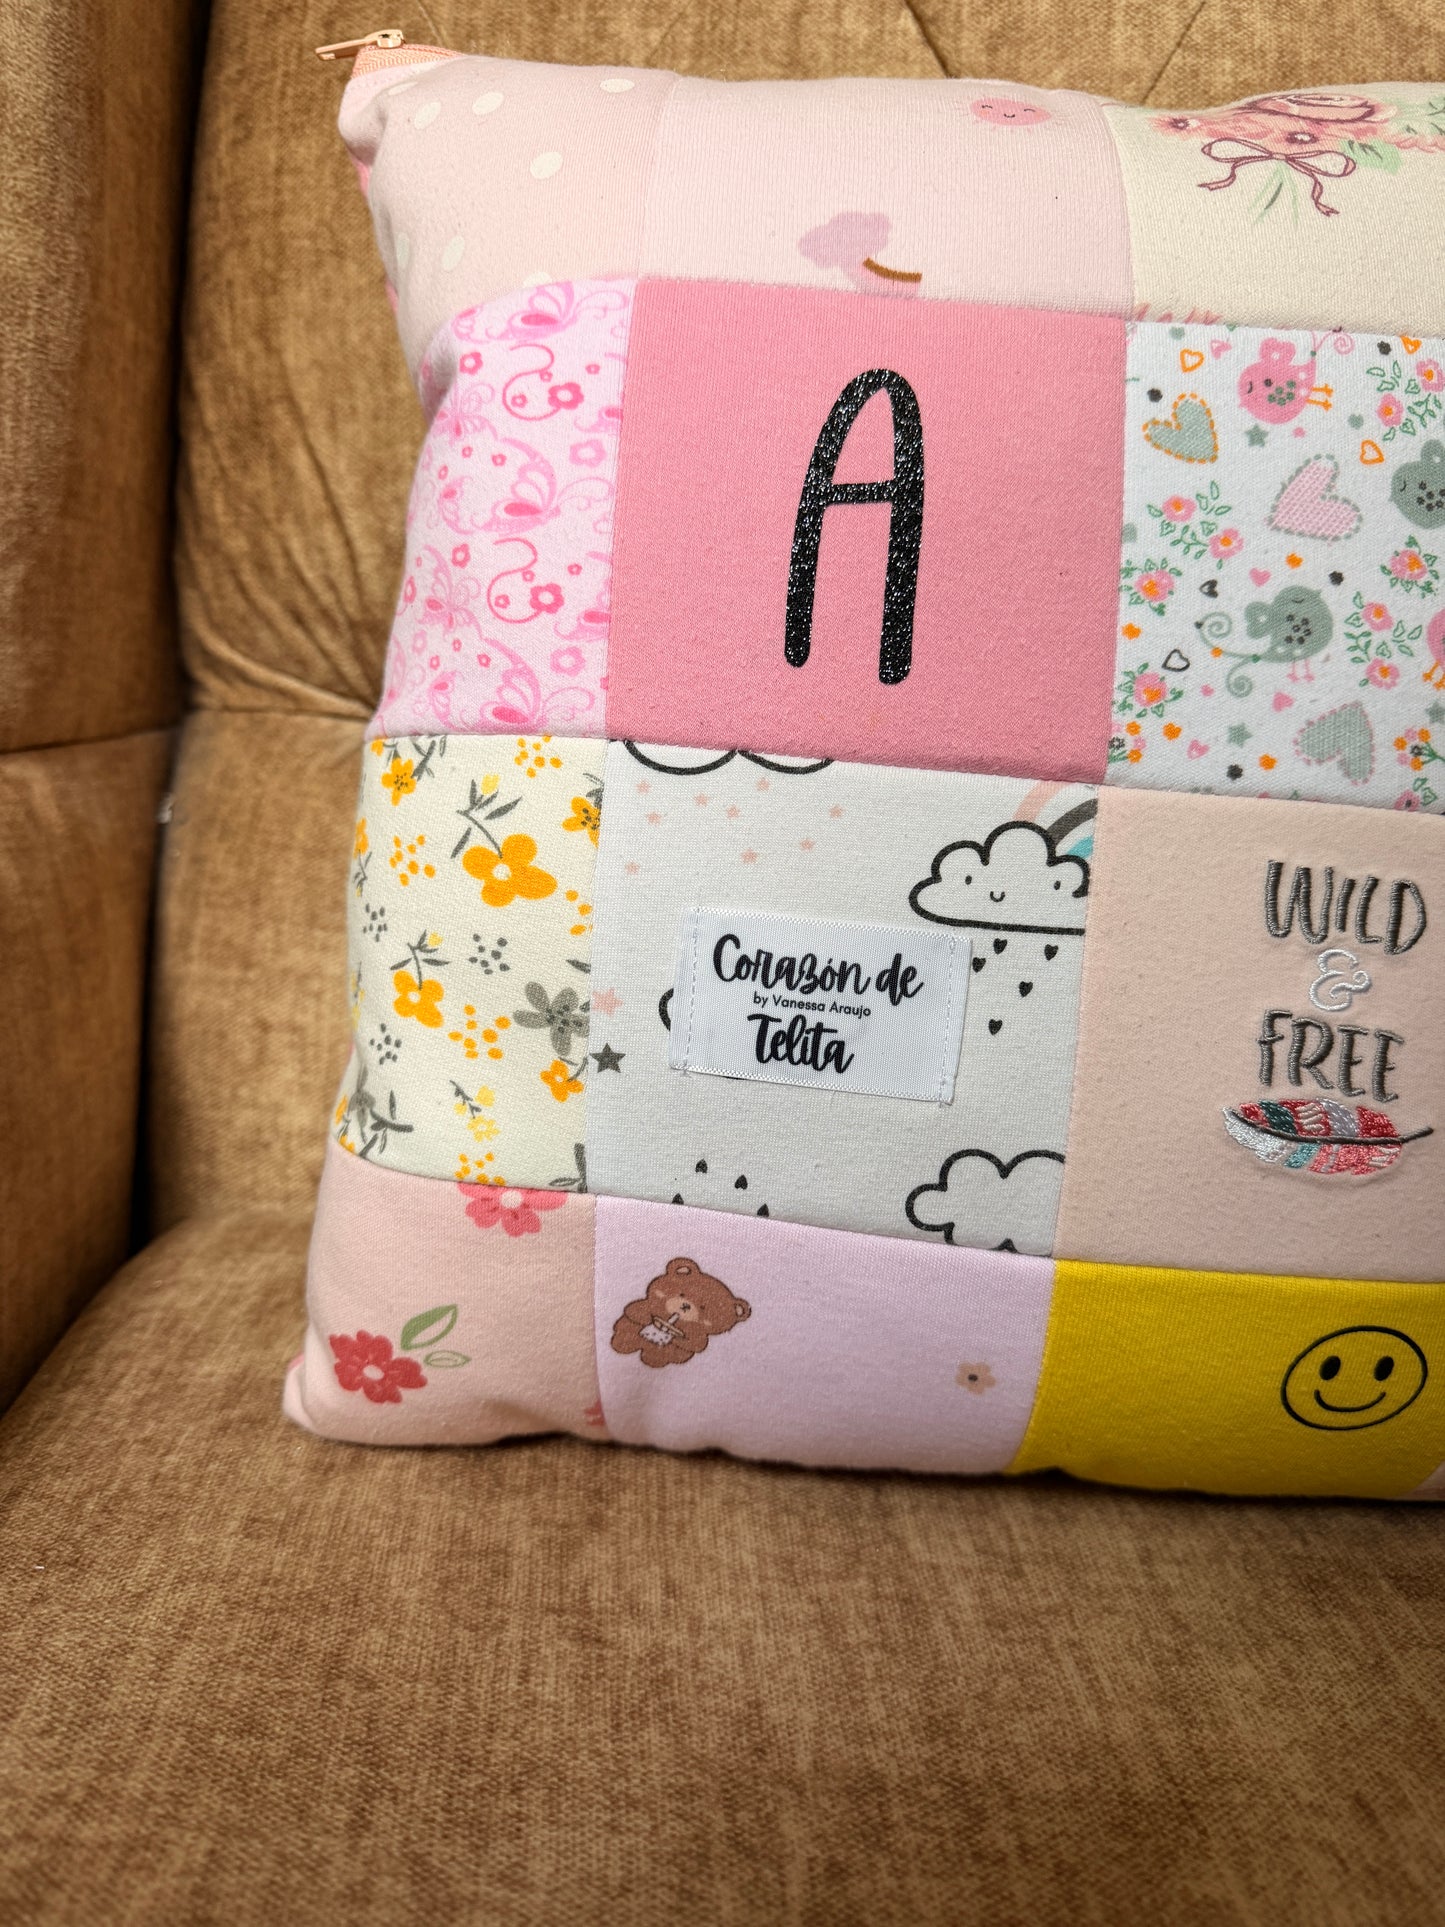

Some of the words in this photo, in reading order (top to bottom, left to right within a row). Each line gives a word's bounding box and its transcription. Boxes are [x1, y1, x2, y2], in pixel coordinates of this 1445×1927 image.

[784, 368, 924, 685] A
[1264, 860, 1427, 955] WILD
[713, 933, 871, 995] Corazón
[875, 953, 924, 1006] de
[753, 991, 769, 1007] by
[772, 994, 826, 1012] Vanessa
[829, 1001, 871, 1018] Araujo
[1309, 949, 1373, 1012] &
[747, 1013, 855, 1074] Telita
[1256, 1009, 1405, 1103] FREE
